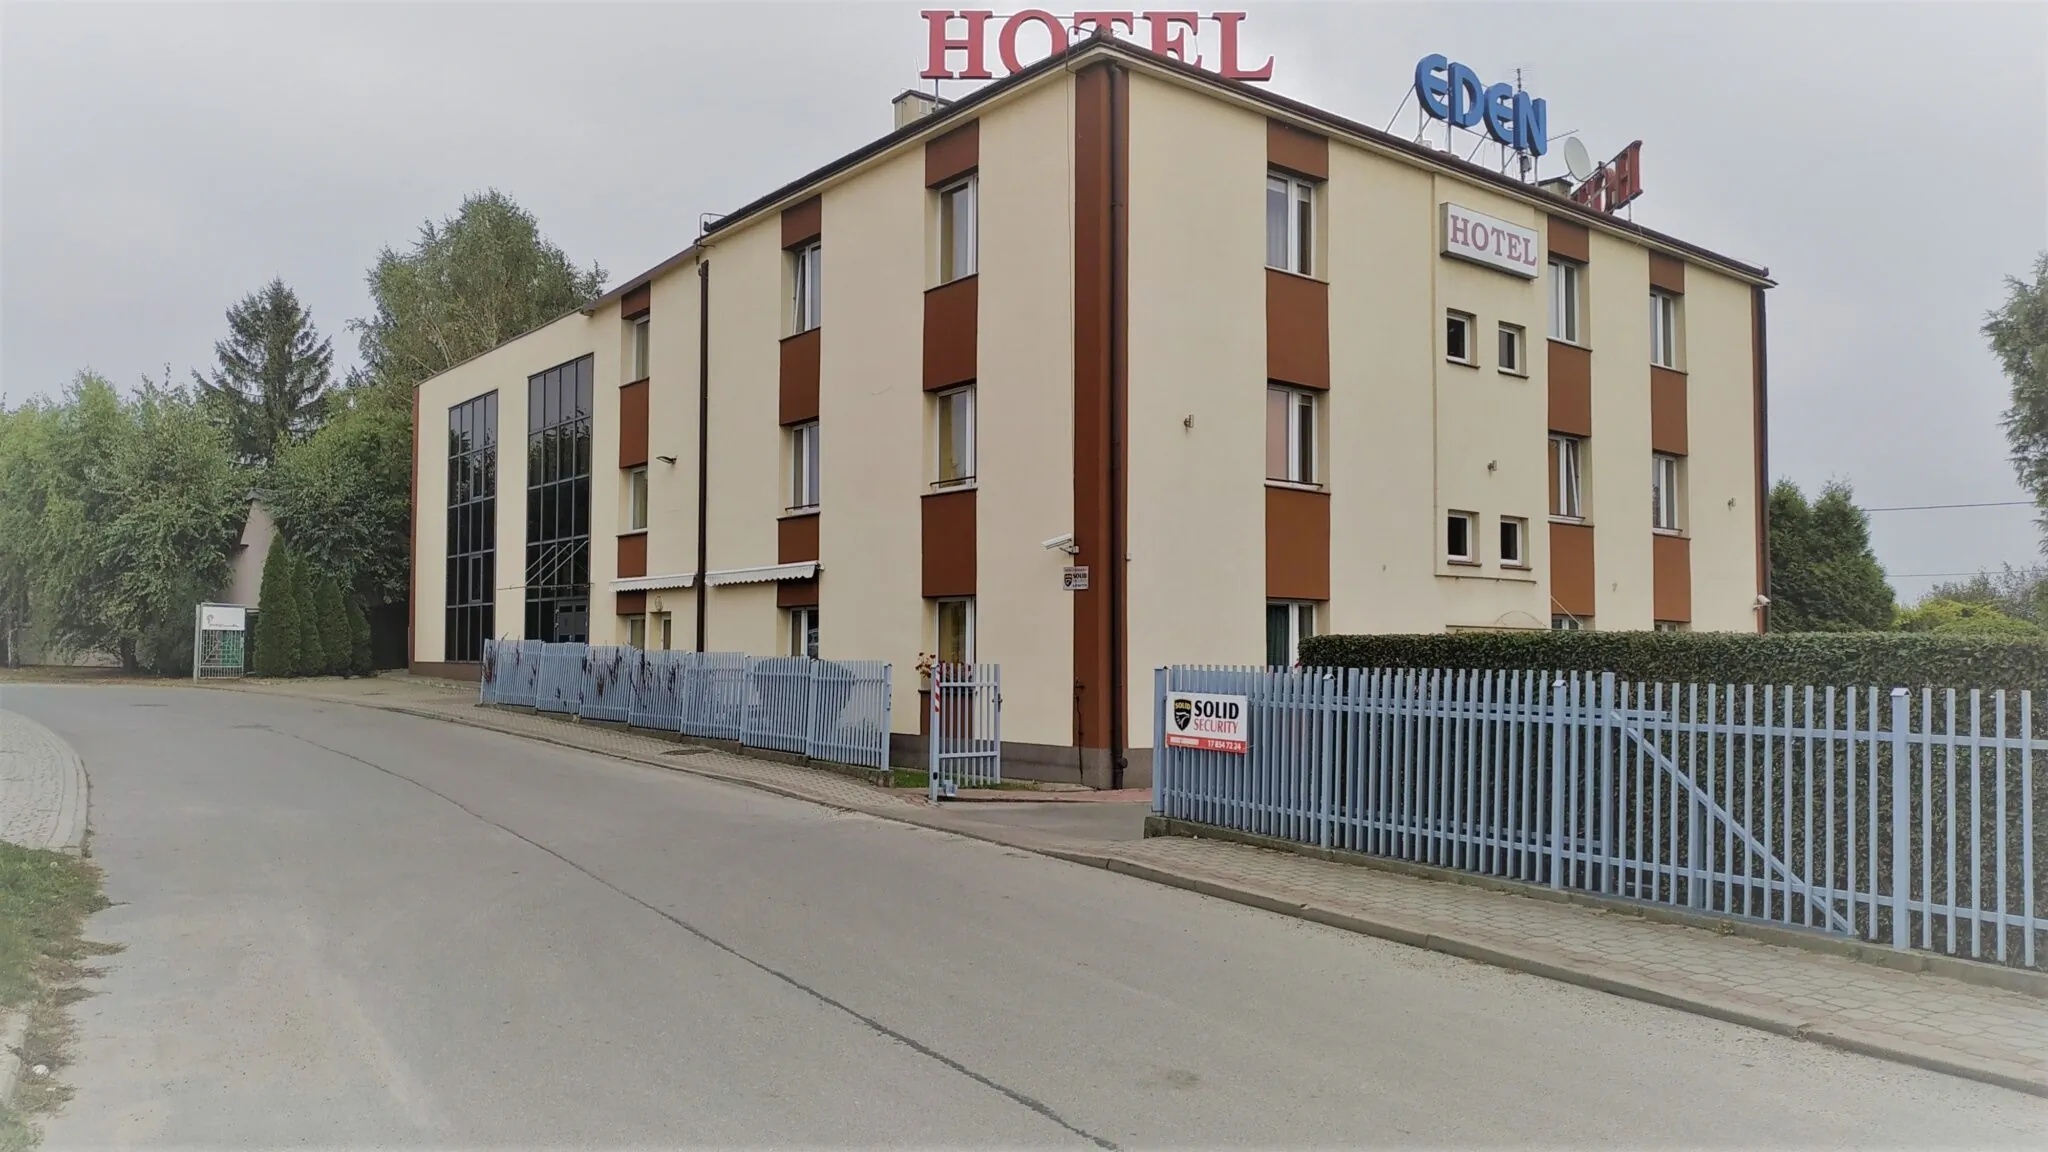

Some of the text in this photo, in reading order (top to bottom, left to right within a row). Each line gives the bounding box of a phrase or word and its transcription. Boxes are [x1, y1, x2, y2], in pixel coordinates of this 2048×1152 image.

[920, 9, 1274, 81] HOTEL
[1415, 53, 1547, 156] EDEN
[1450, 214, 1537, 267] HOTEL
[1194, 700, 1239, 719] SOLID
[1194, 718, 1238, 734] SECURITY
